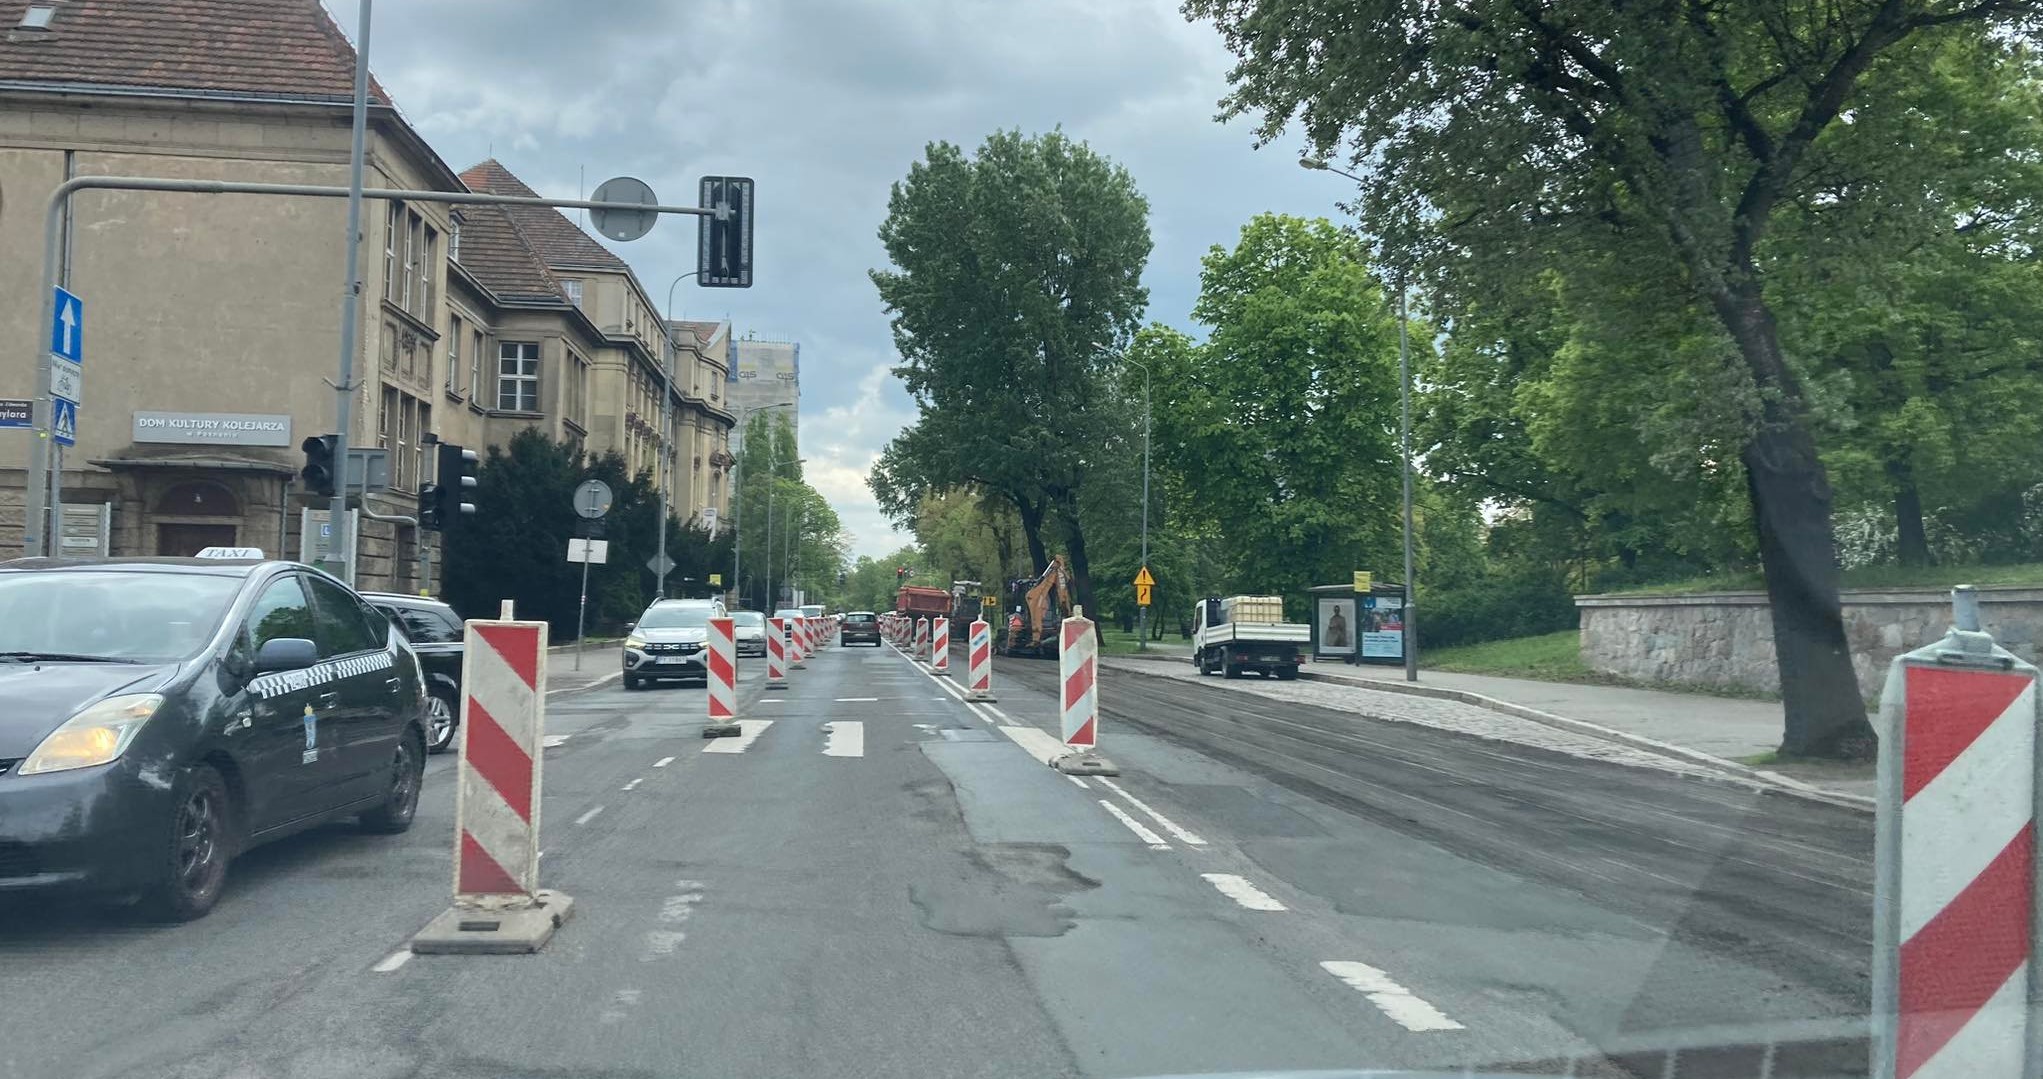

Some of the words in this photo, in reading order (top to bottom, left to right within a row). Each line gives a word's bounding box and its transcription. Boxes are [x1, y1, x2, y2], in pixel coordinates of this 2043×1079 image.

[139, 418, 165, 428] DOM
[168, 419, 220, 429] KULTURY
[223, 420, 285, 431] KOLEJARZA
[206, 549, 249, 557] TAXI
